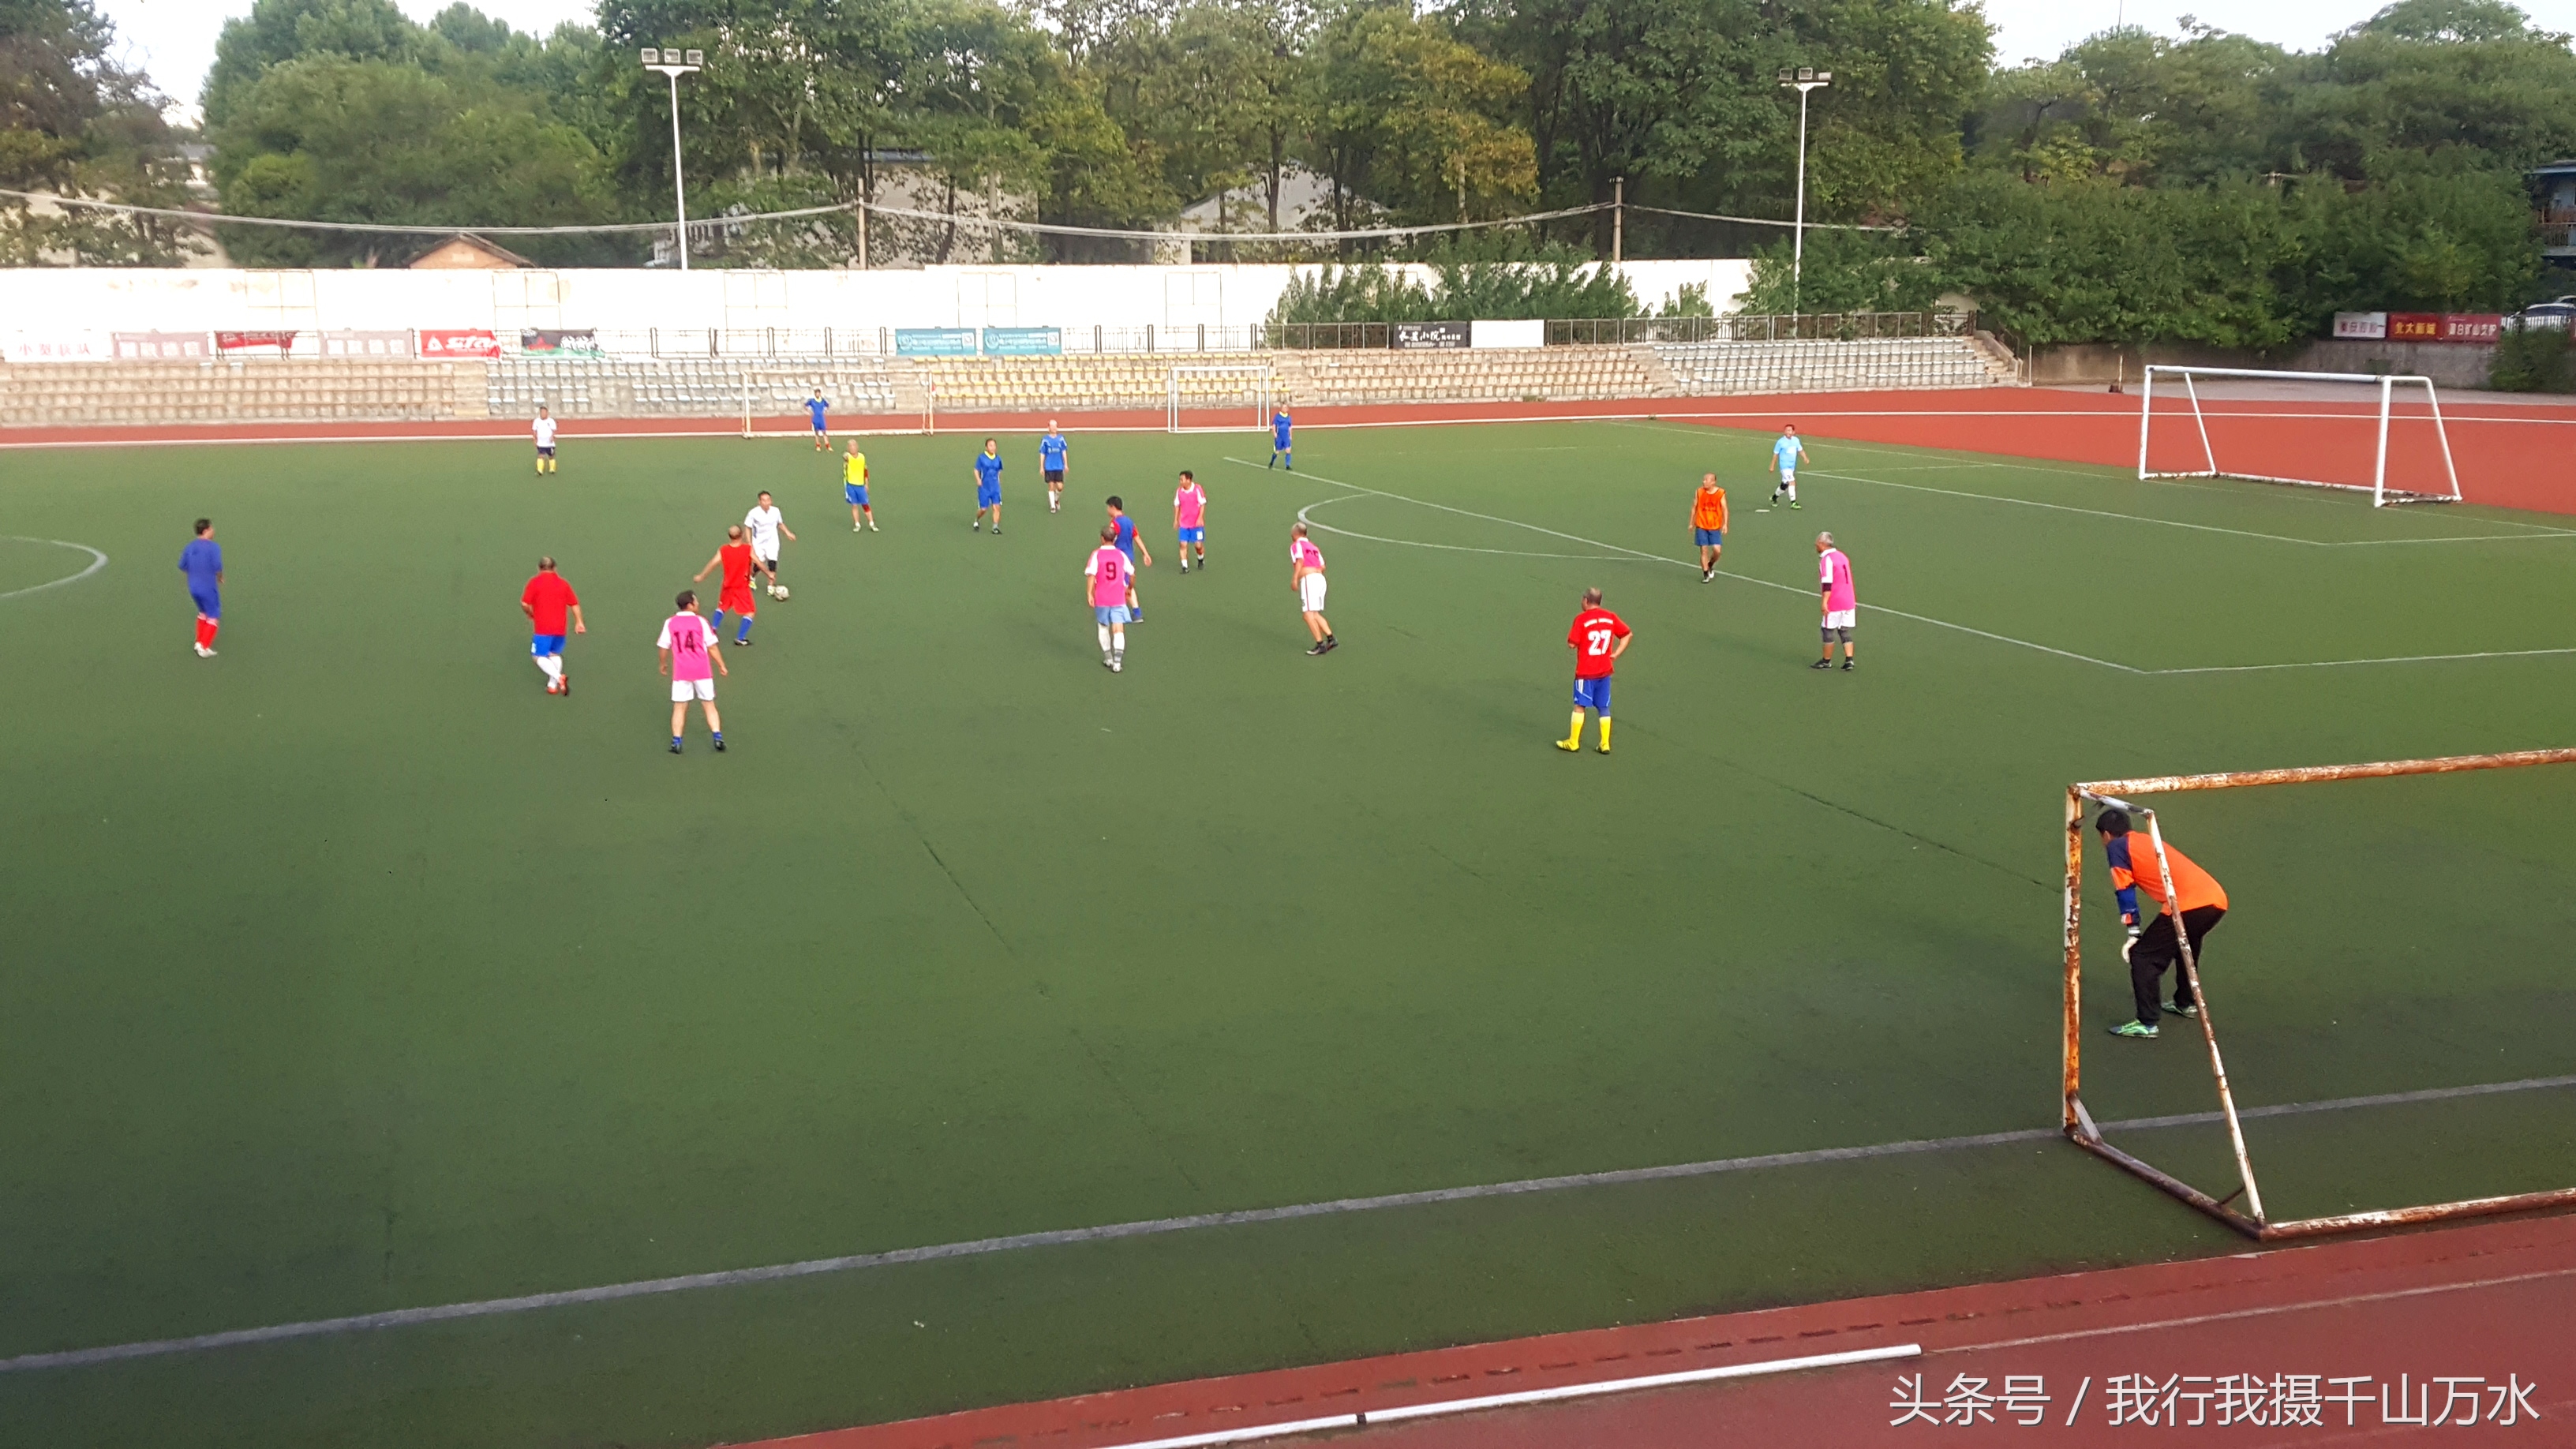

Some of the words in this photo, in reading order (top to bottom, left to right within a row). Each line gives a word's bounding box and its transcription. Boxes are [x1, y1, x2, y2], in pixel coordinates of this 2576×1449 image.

[1105, 561, 1117, 581] 9
[673, 630, 696, 653] 14
[1587, 629, 1612, 656] 27
